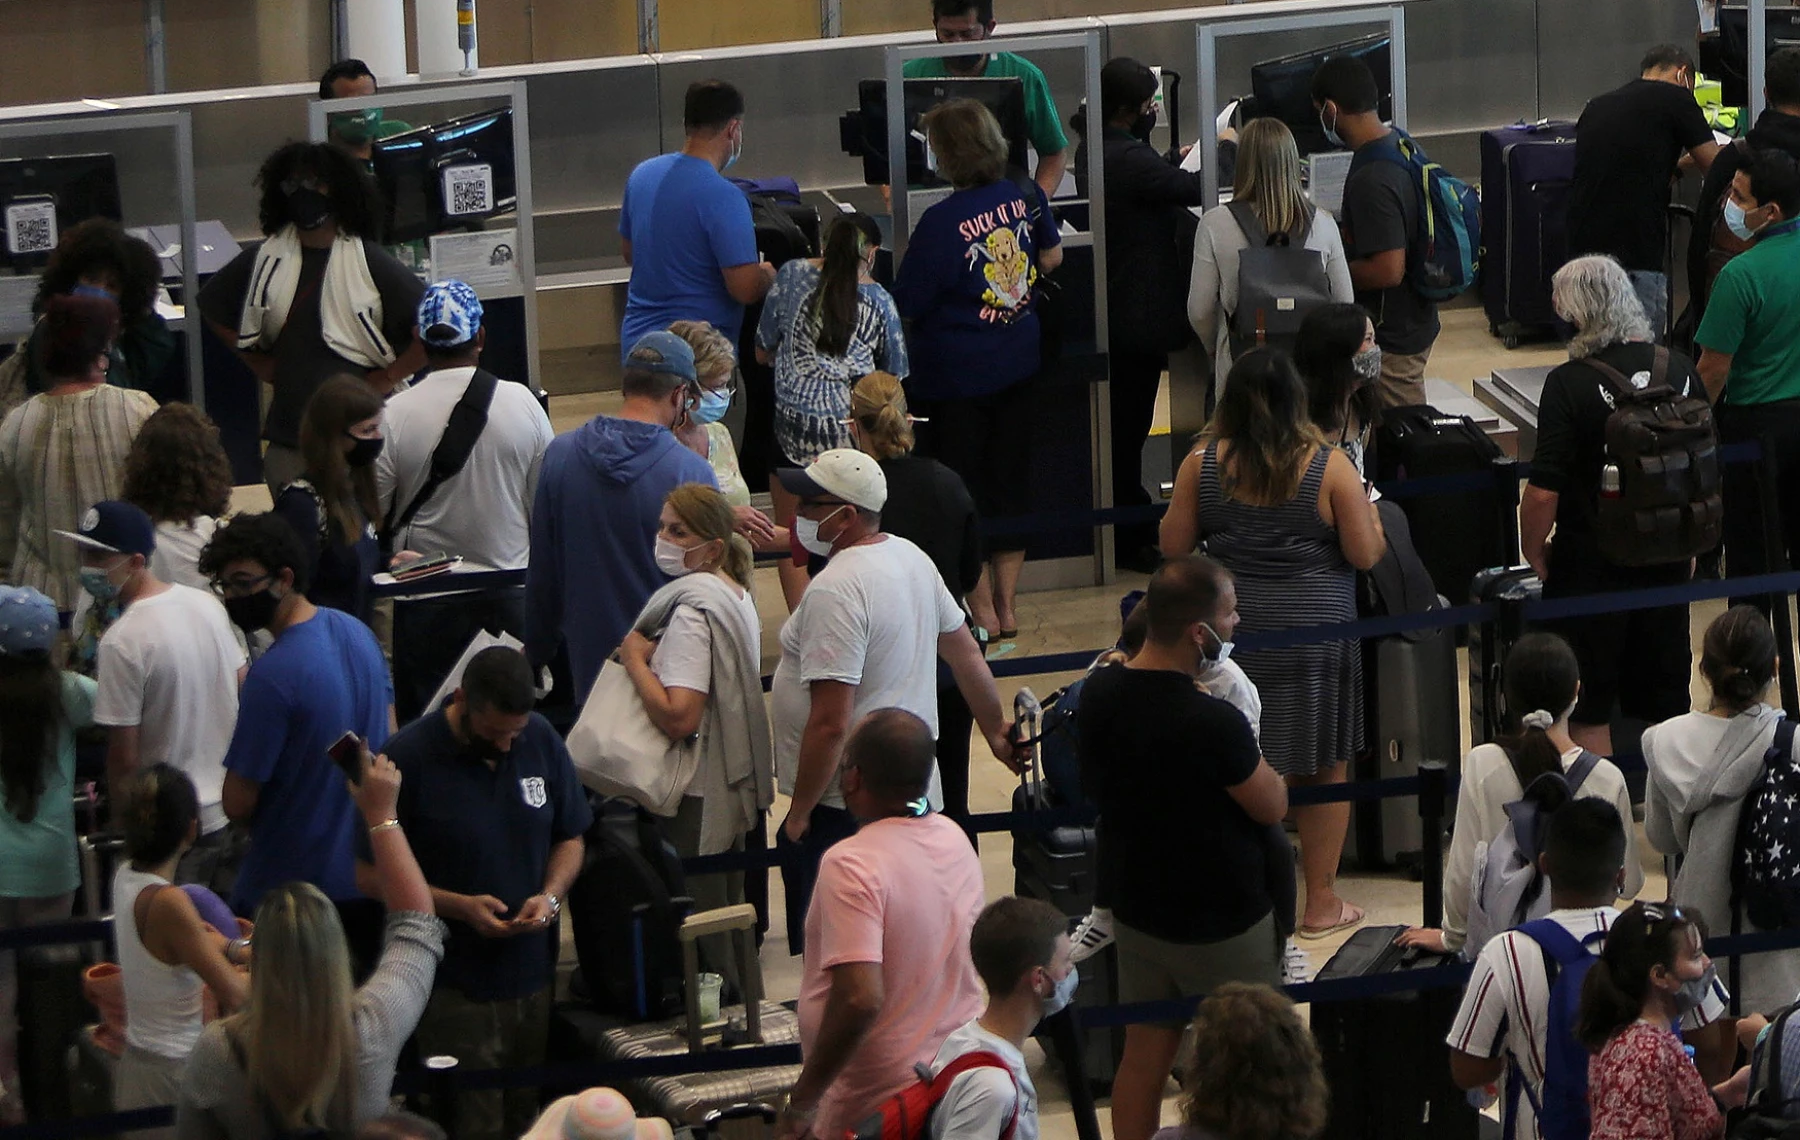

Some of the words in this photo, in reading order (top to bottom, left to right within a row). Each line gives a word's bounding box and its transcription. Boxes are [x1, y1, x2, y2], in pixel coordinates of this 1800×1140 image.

[959, 211, 998, 242] SUCK
[996, 203, 1010, 225] IT
[1011, 199, 1027, 219] UP
